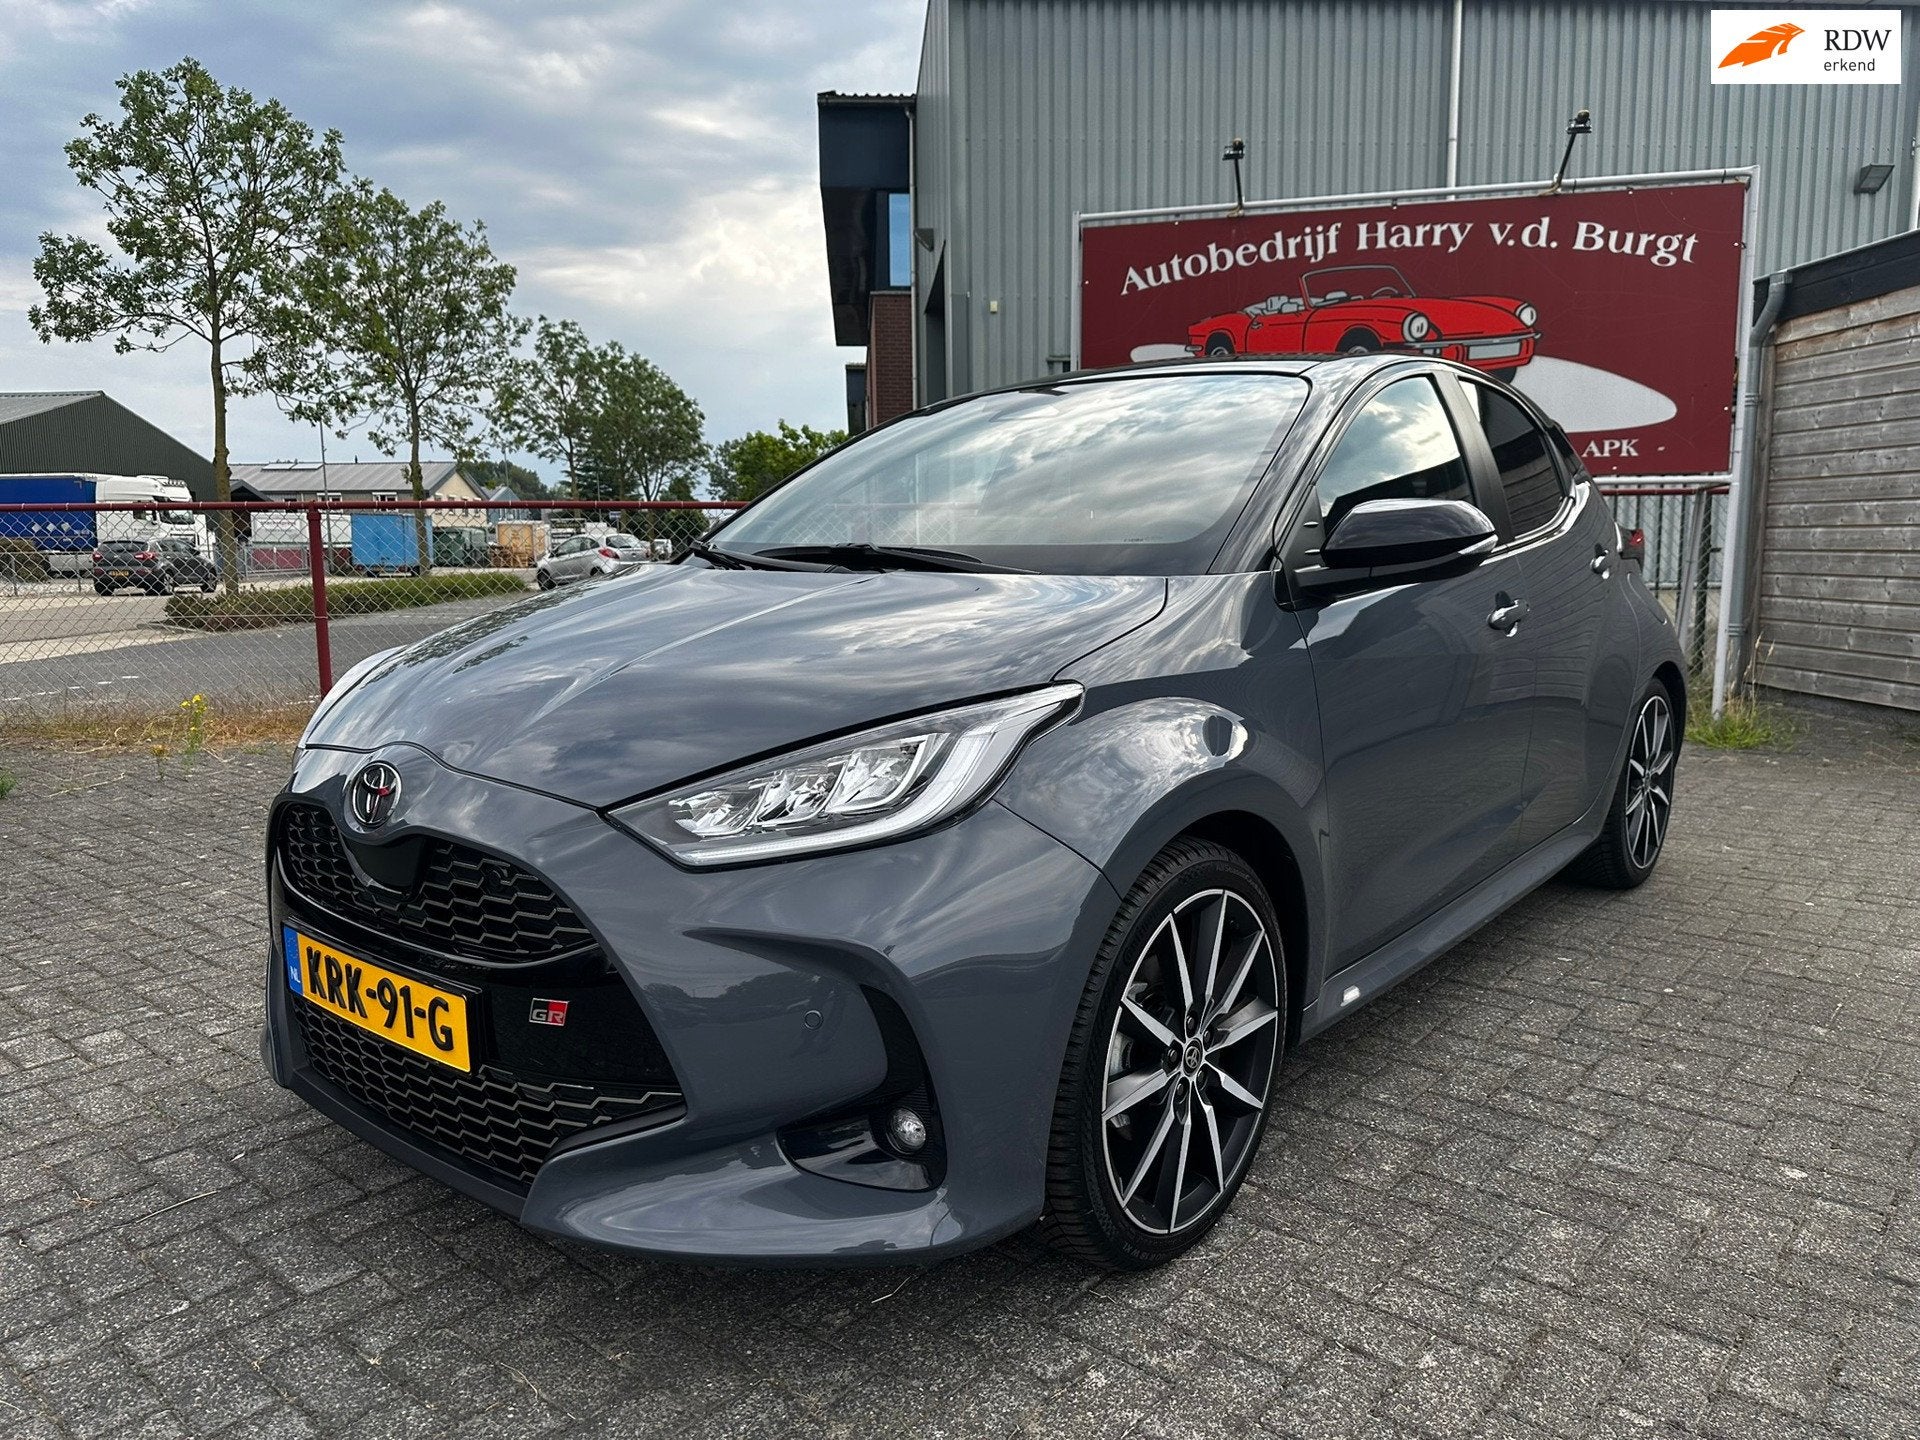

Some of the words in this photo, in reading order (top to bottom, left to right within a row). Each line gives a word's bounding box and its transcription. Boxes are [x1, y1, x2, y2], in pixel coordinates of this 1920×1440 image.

[1120, 222, 1342, 296] Autobedrijf
[1356, 219, 1474, 254] Harry
[1488, 216, 1558, 249] v.d.
[1572, 221, 1699, 267] Burgt
[1581, 438, 1639, 457] APK
[289, 966, 301, 983] NL
[306, 945, 454, 1052] KRK-91-G
[531, 1008, 565, 1023] GR
